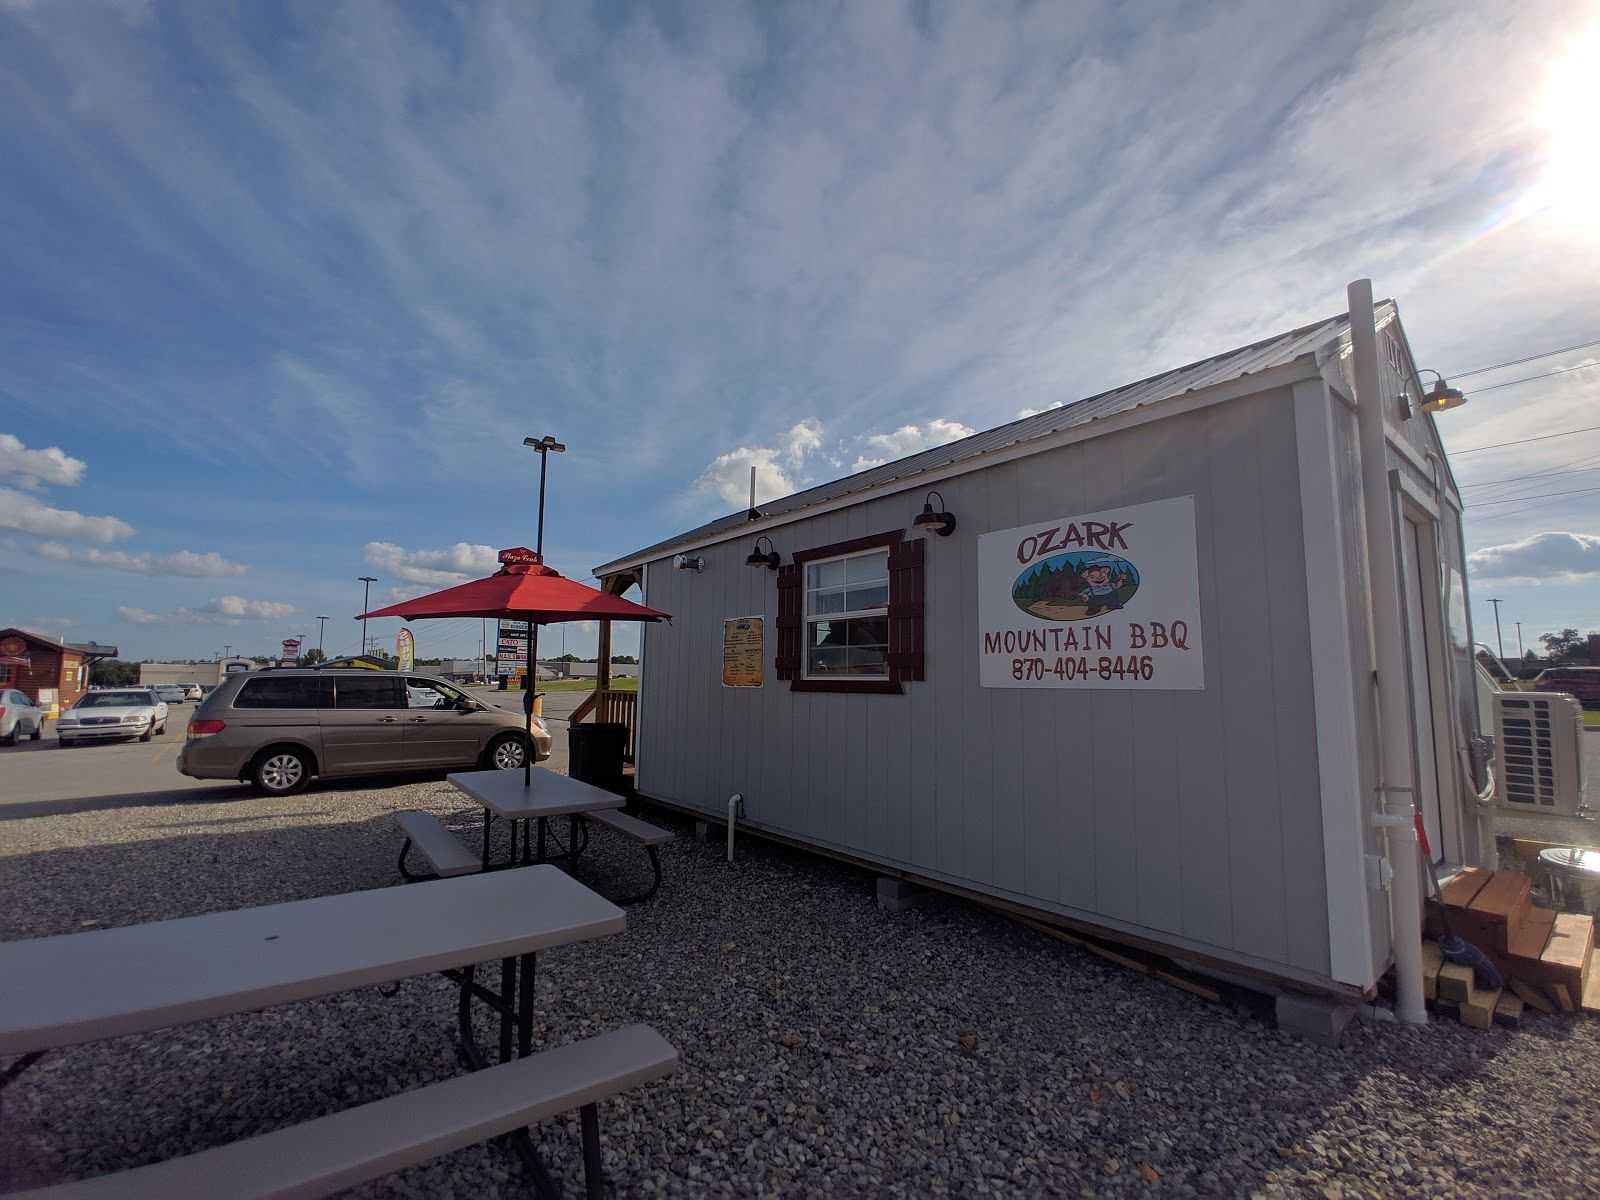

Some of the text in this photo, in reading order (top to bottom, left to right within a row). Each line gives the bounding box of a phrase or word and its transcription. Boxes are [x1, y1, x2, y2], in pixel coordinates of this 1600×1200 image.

[1016, 521, 1134, 564] OZARK
[984, 620, 1191, 655] MOUNTAIN BBQ
[1012, 656, 1154, 681] 870-404-8446
